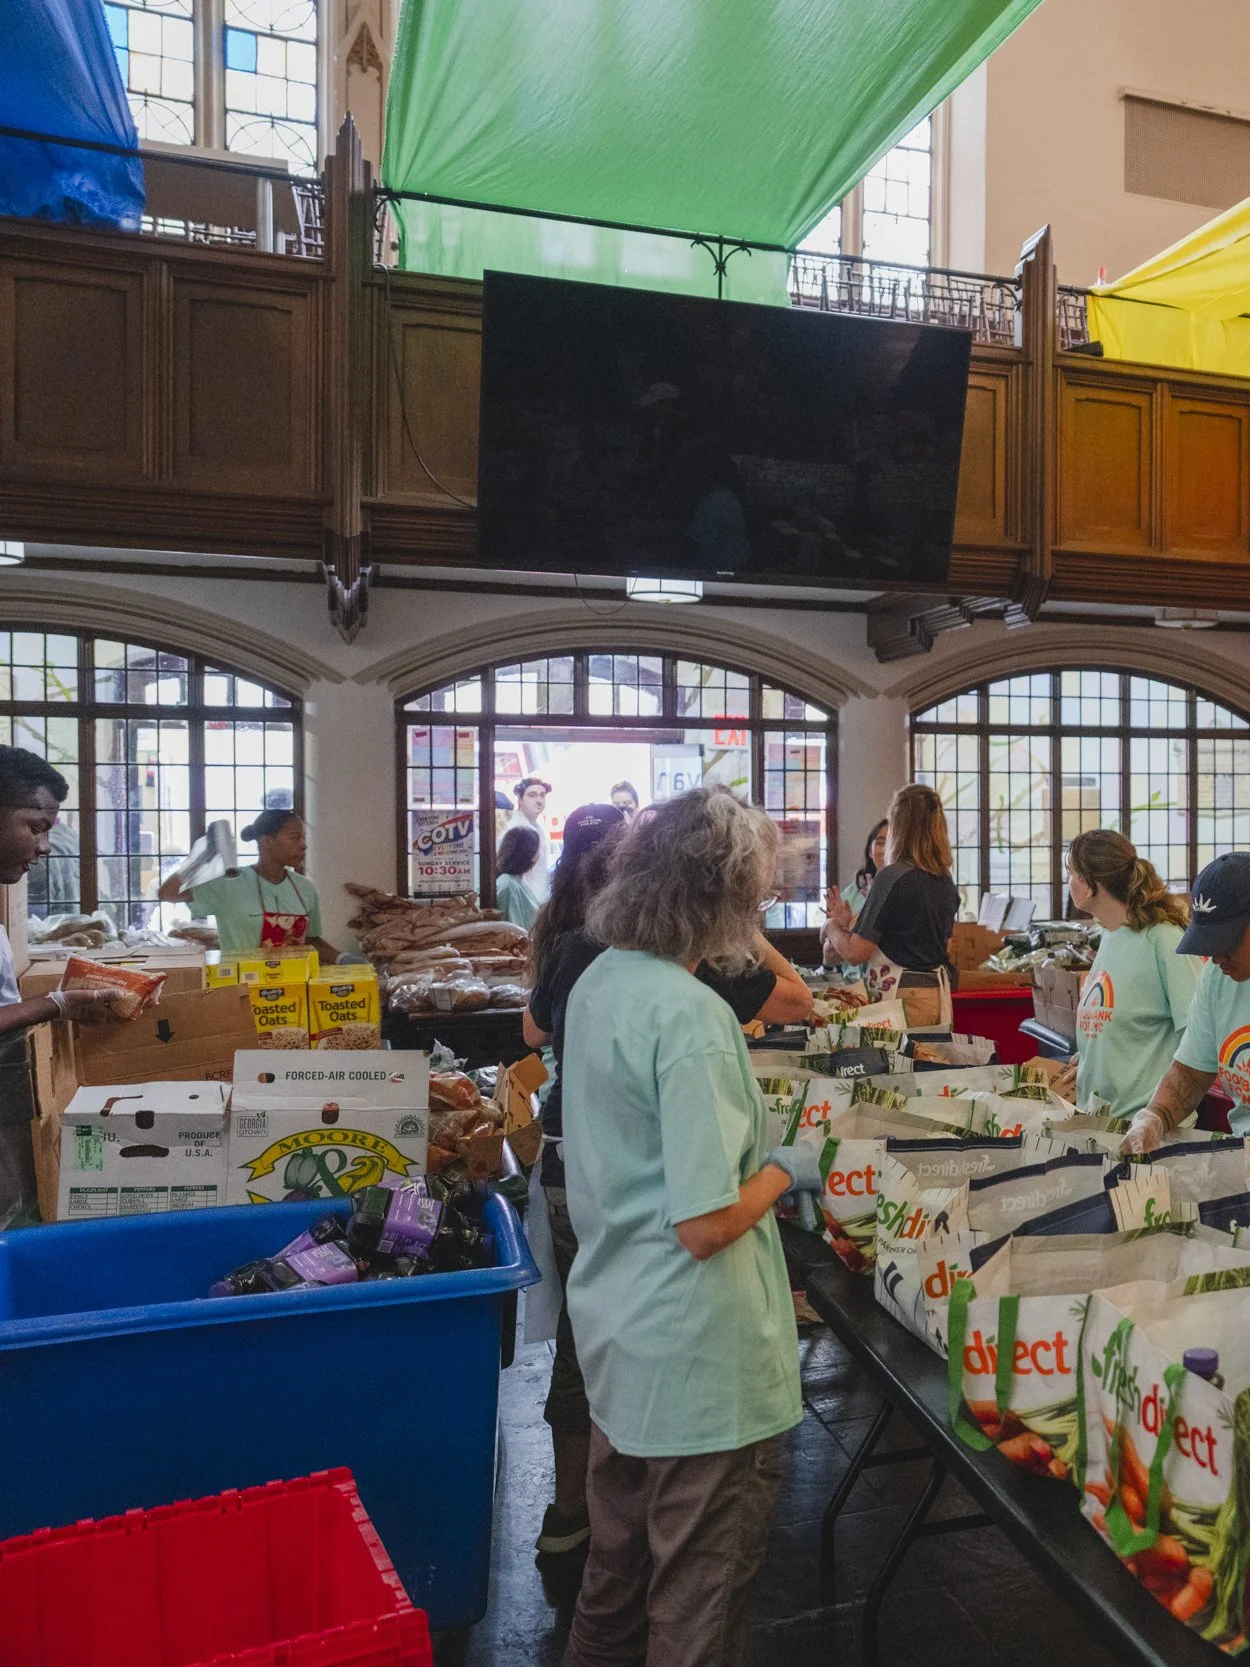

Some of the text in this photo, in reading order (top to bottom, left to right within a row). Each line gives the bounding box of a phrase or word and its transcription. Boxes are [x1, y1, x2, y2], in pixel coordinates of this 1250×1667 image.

[417, 820, 470, 850] COTV
[419, 866, 456, 875] 10:30
[252, 1002, 296, 1014] oasted
[318, 998, 366, 1011] Toasted
[258, 1014, 288, 1027] Oats
[329, 1010, 358, 1022] Oats
[285, 1071, 386, 1081] FORCED-AIR COOLED
[239, 1116, 267, 1130] GEORGIA
[179, 1131, 221, 1139] PRODUCE
[239, 1129, 268, 1138] grown
[279, 1131, 388, 1155] MOORE
[185, 1149, 213, 1157] U.S.A.
[963, 1330, 1072, 1375] diect
